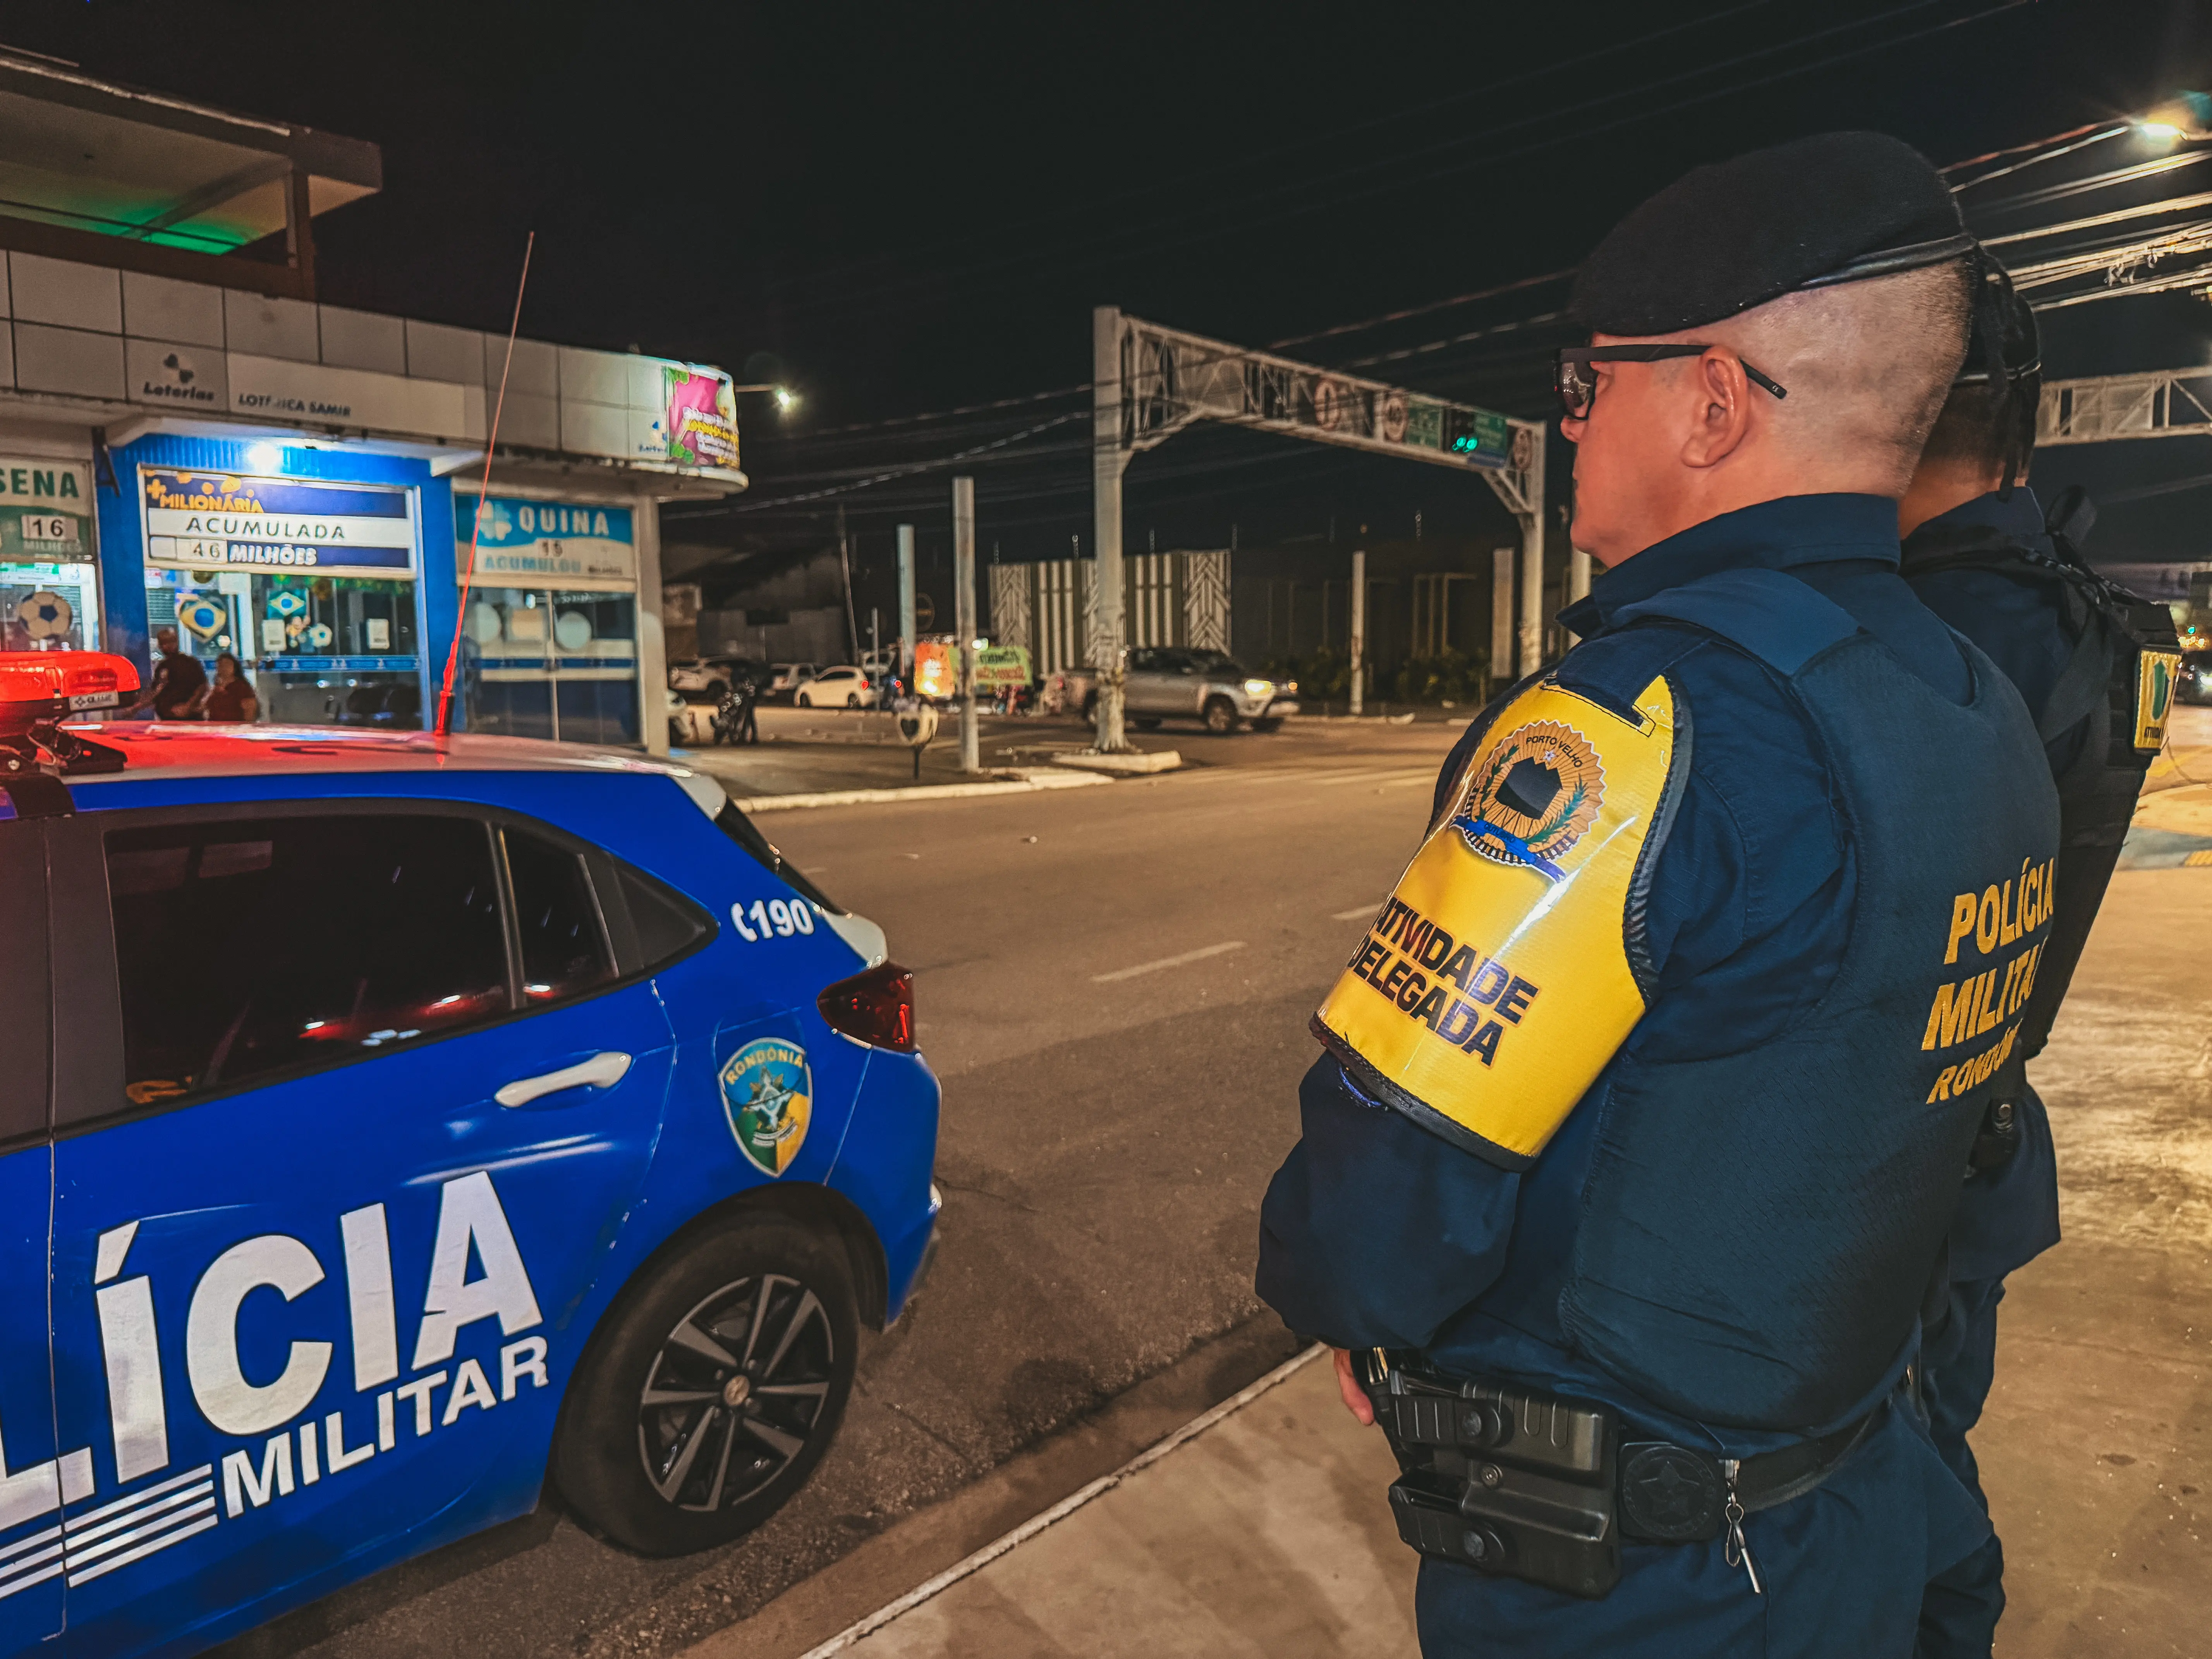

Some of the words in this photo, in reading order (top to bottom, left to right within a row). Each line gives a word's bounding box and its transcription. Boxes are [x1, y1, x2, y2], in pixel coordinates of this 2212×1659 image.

[33, 518, 64, 537] 16
[186, 517, 345, 539] ACUMULADA
[519, 506, 609, 536] QUINA
[193, 539, 220, 558] 46
[230, 544, 317, 565] MILHÕES
[485, 555, 580, 572] ACUMULOU
[1526, 735, 1557, 745] PORTO
[1558, 740, 1583, 768] VELHO
[749, 898, 814, 939] 190
[1944, 857, 2054, 964] POLÍCIA
[1921, 935, 2049, 1051] MILITA
[222, 1336, 549, 1518] MILITAR
